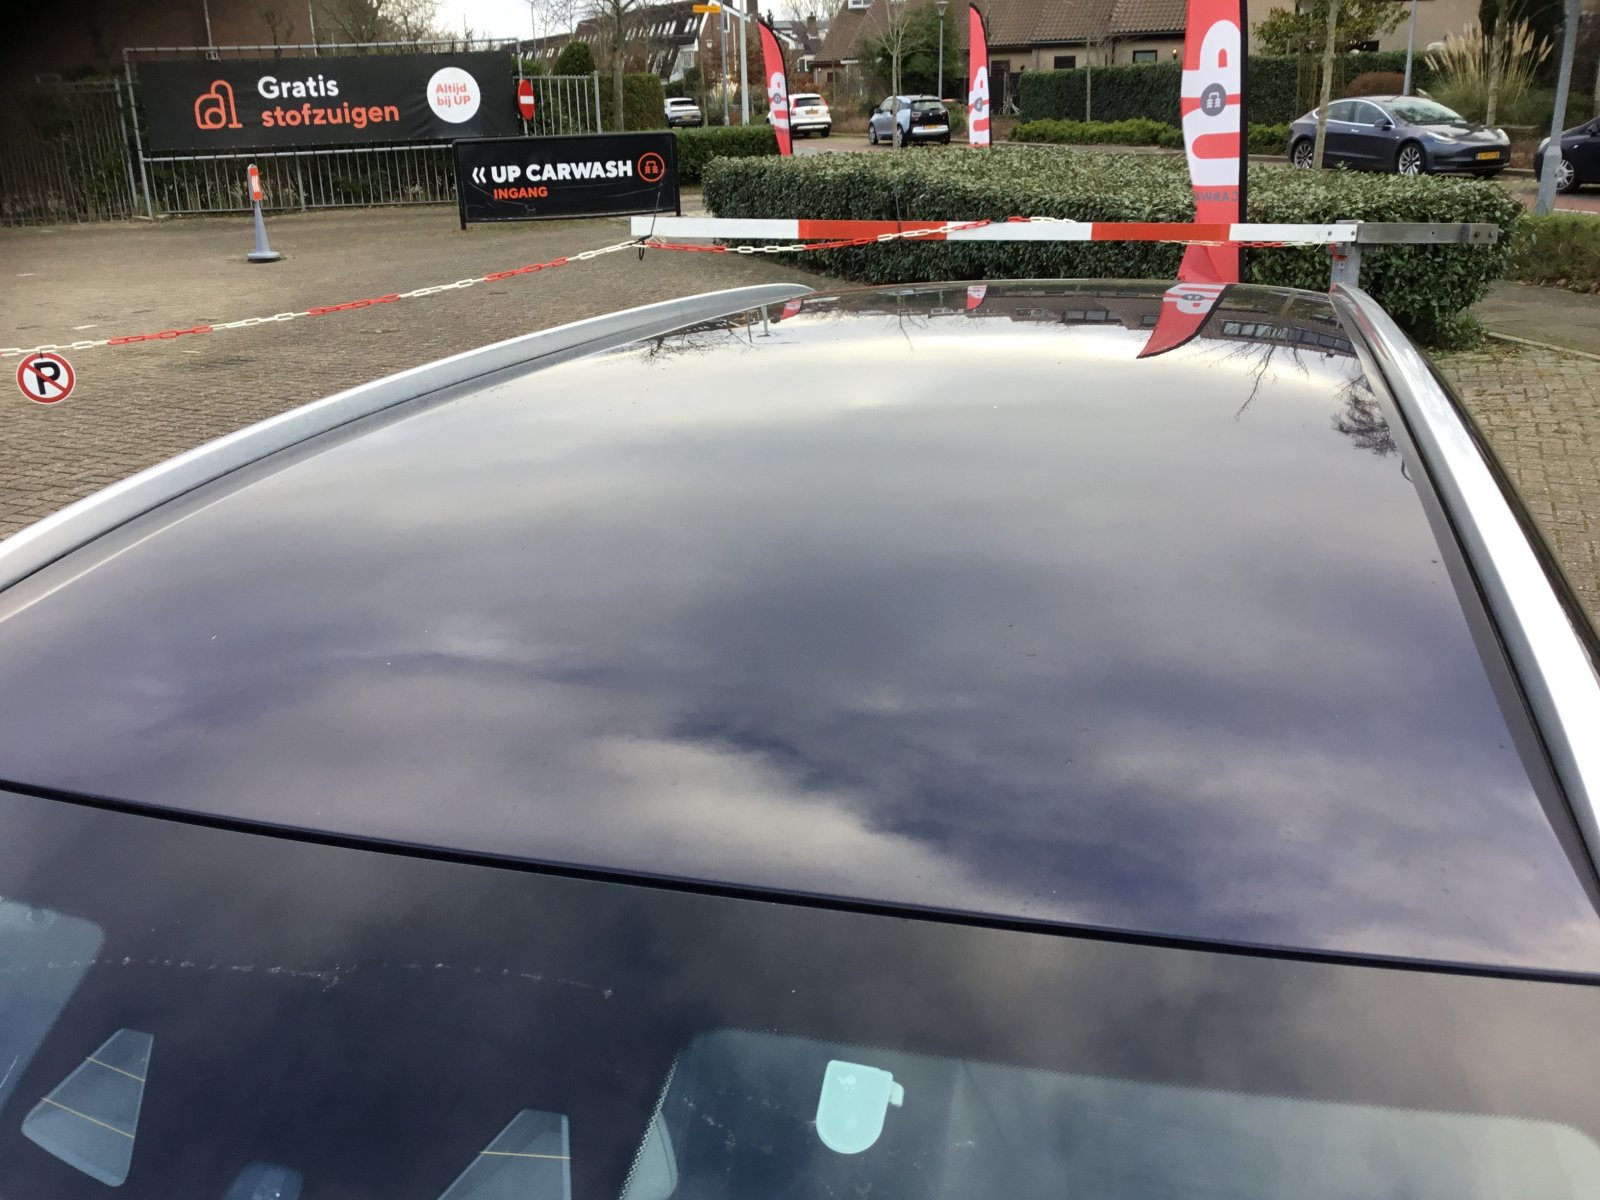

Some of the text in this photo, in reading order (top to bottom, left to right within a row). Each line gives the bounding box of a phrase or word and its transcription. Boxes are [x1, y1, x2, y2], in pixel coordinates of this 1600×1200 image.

[257, 74, 339, 99] Gratis
[436, 82, 467, 95] Altijd
[436, 95, 471, 108] bij UP
[261, 101, 400, 129] stofzuigen
[491, 159, 633, 184] UP CARWASH
[493, 186, 548, 200] INGANG
[33, 361, 61, 395] P
